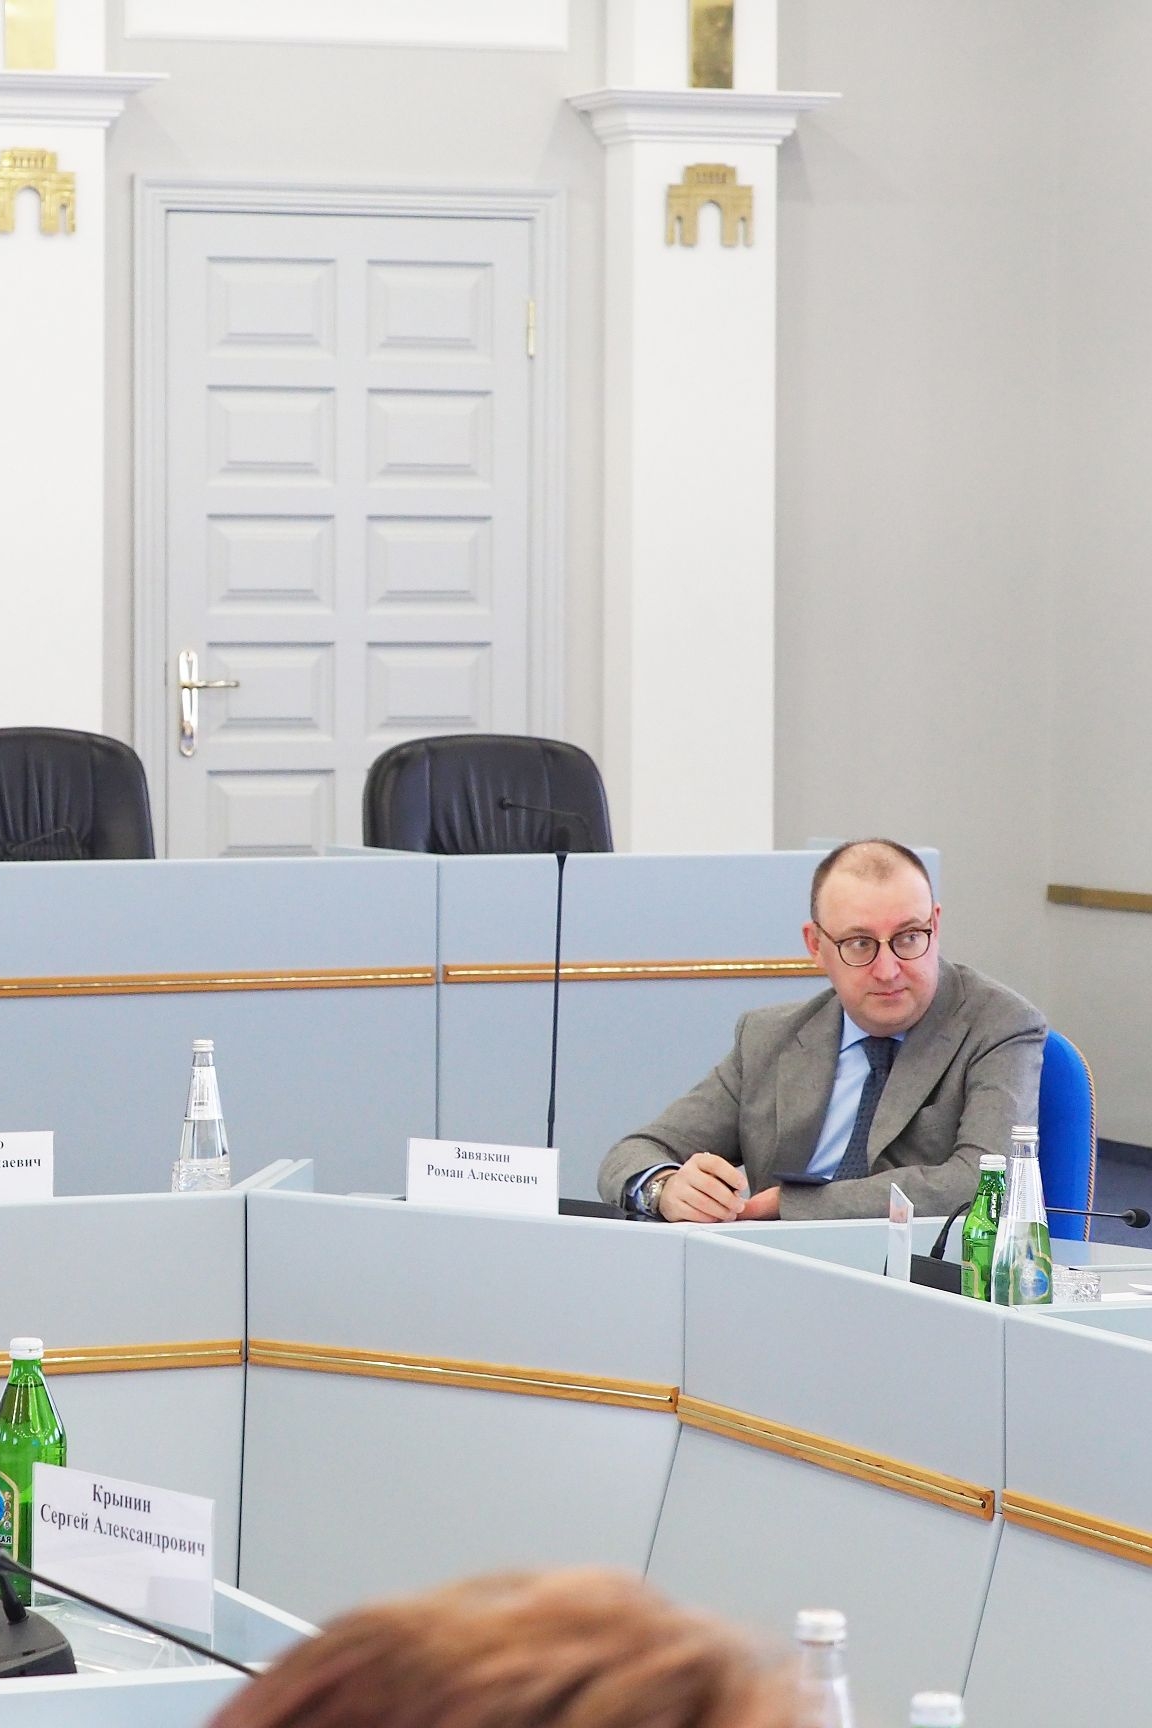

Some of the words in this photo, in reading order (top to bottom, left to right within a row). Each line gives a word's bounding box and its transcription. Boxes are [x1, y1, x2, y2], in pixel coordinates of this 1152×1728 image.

[454, 1147, 510, 1163] Завязкин
[427, 1164, 464, 1179] Роман
[467, 1168, 538, 1185] Алексеевич
[92, 1483, 152, 1514] Крынин
[40, 1503, 89, 1530] Сергей
[93, 1516, 206, 1557] Александрович
